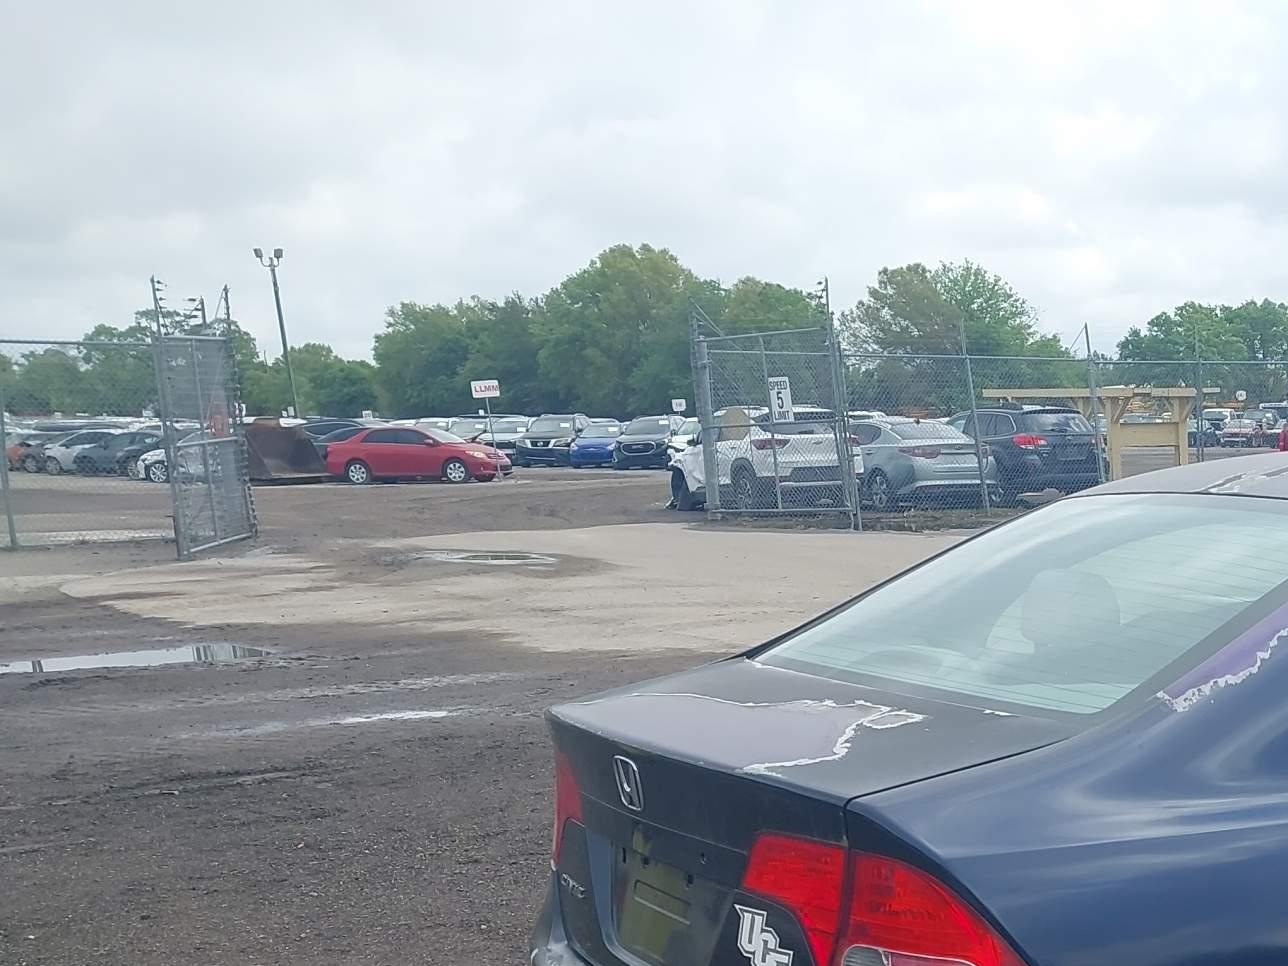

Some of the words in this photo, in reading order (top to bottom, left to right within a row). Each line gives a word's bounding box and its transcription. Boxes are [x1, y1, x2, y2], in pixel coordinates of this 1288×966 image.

[769, 380, 788, 391] SPEED
[776, 391, 784, 409] 5
[774, 410, 790, 420] LIMIT
